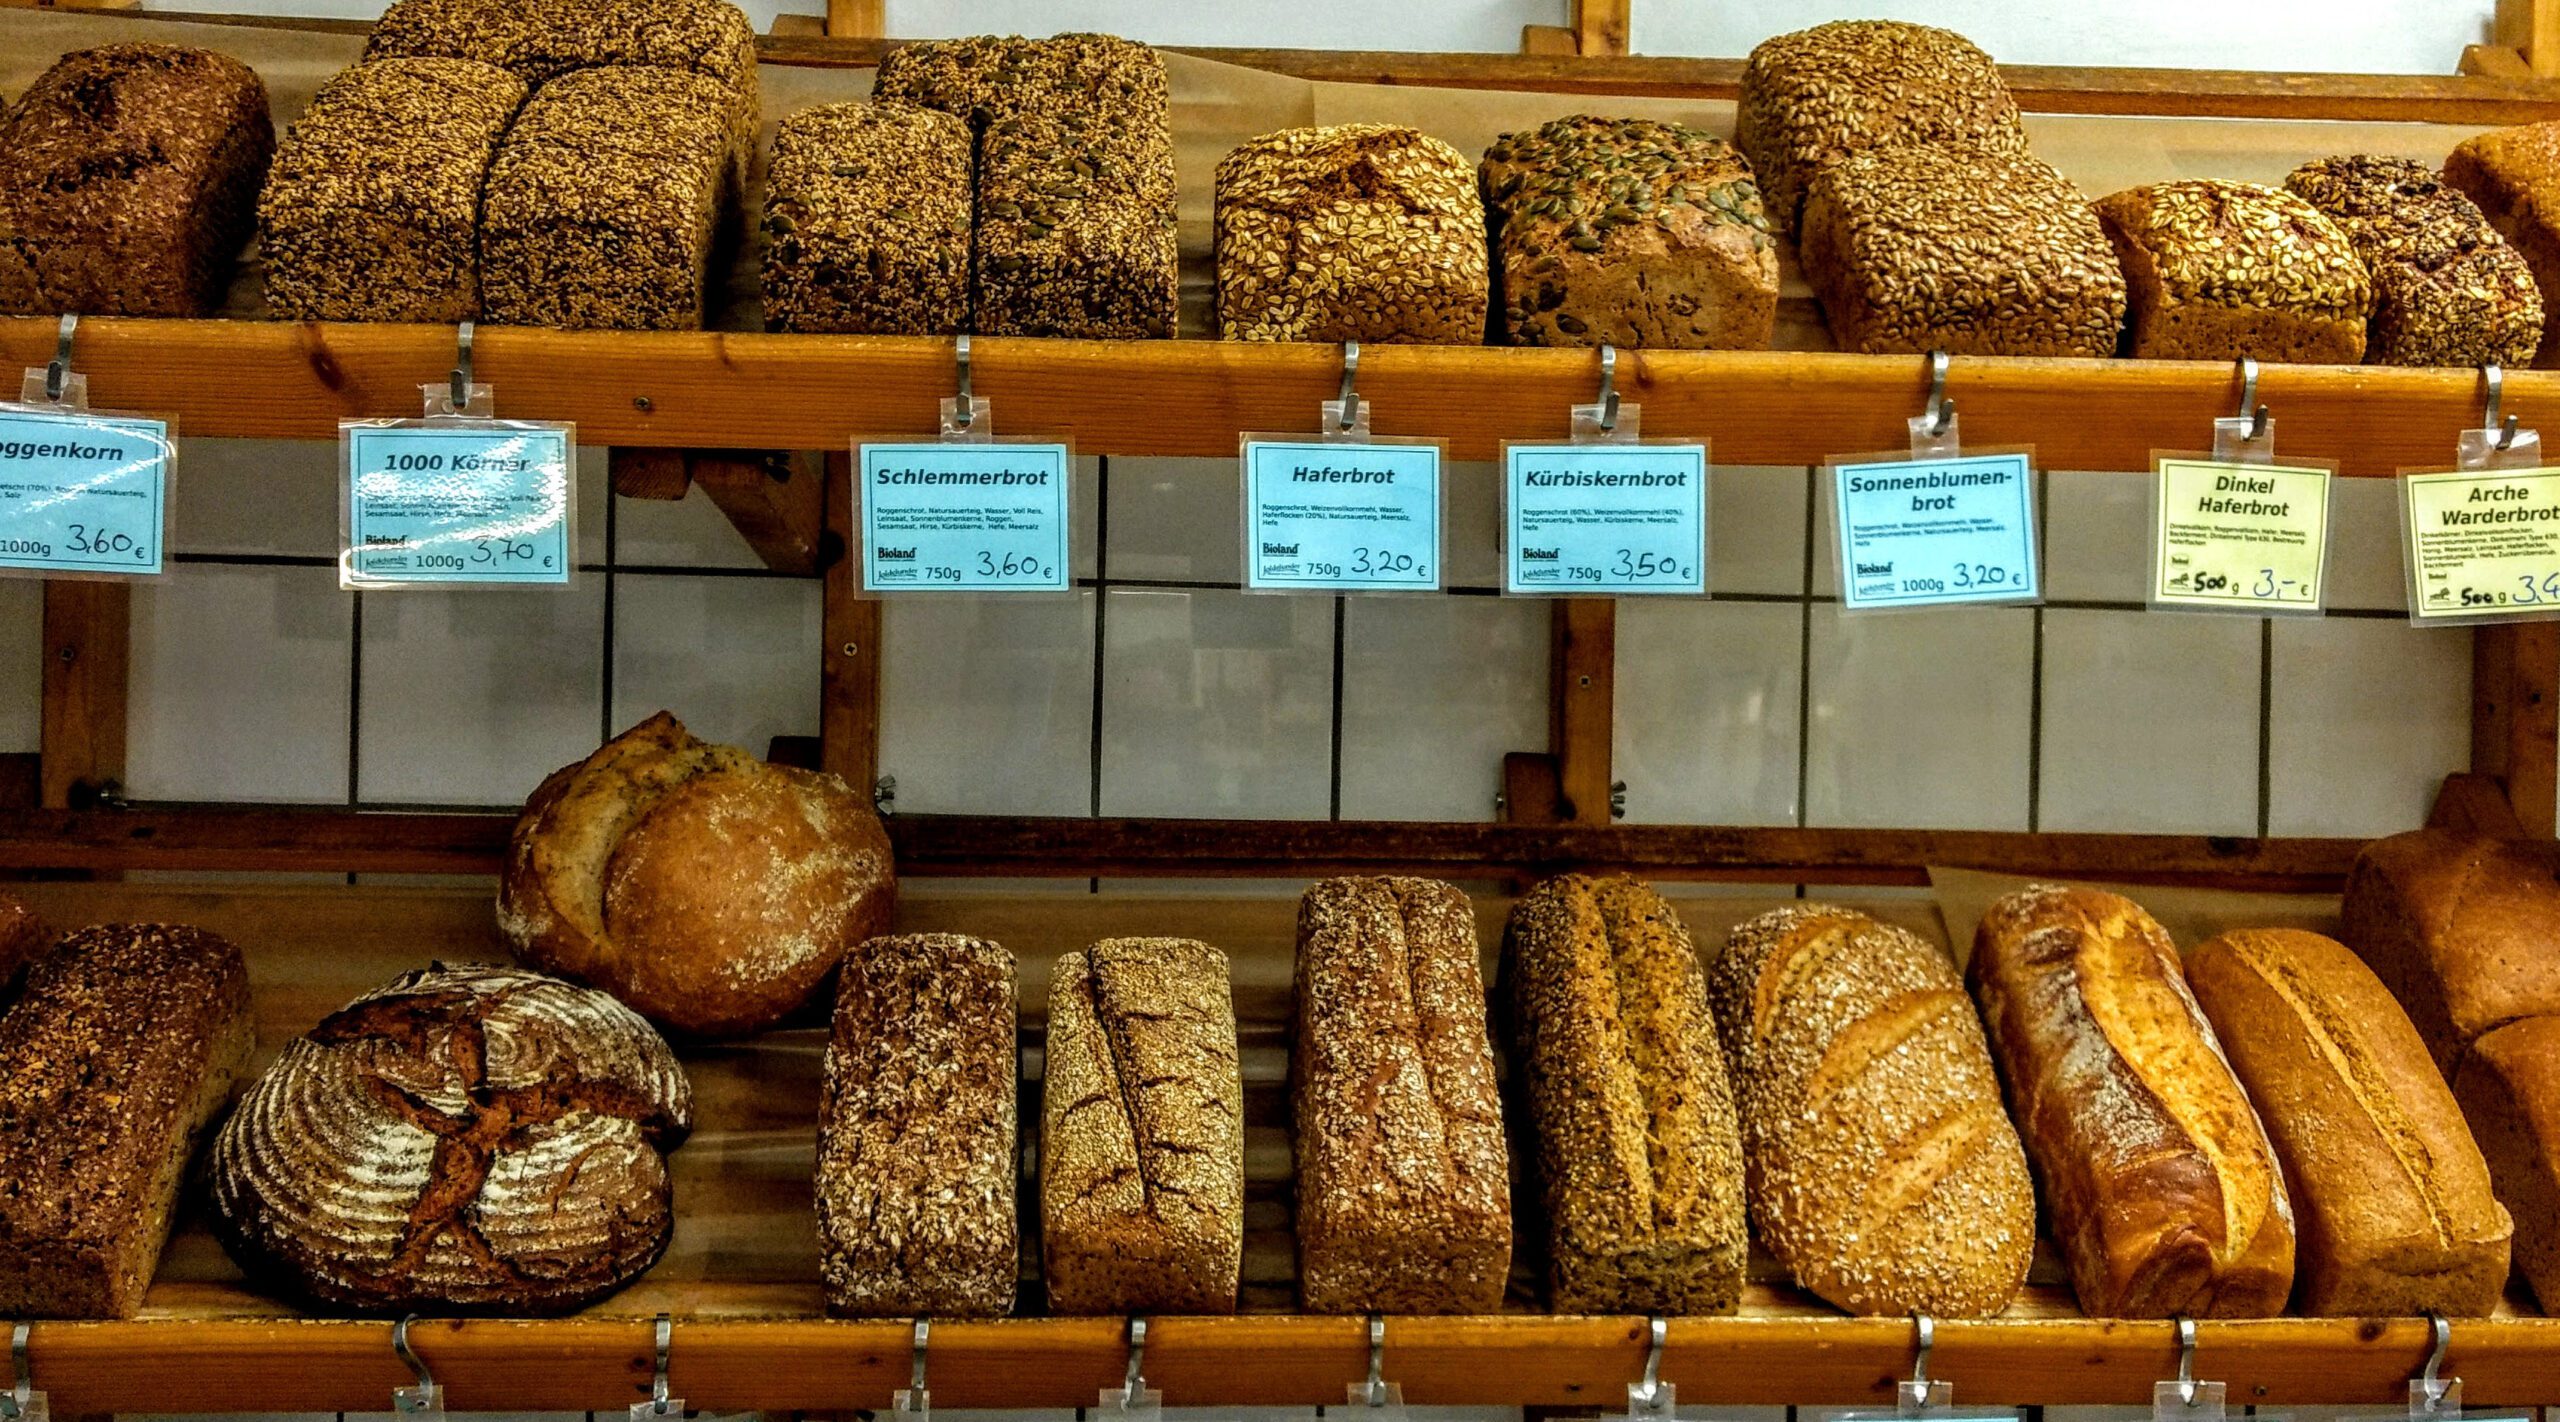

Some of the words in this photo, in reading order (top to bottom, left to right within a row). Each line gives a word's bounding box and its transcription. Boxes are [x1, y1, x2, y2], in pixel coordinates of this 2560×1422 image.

[0, 442, 123, 460] ggenkorn
[385, 455, 443, 471] 1000
[451, 454, 531, 471] Körner
[877, 469, 1048, 485] Schlemmerbrot
[1293, 467, 1395, 484] Haferbrot
[1525, 471, 1687, 487] Kürbiskernbrot
[1850, 471, 2012, 492] Sonnenblumen-
[2216, 476, 2275, 494] Dinkel
[2468, 485, 2529, 503] Arche
[929, 507, 982, 515] Natursauerteig,
[1912, 495, 1956, 511] brot
[2198, 497, 2289, 517] Haferbrot
[1329, 513, 1379, 521] Natursauerteig,
[2442, 506, 2560, 525] Warderbrot
[0, 540, 50, 557] 1000g
[66, 524, 132, 554] 3,60
[135, 547, 144, 559] €
[366, 535, 407, 545] Bioland
[1263, 543, 1299, 554] Bioland
[417, 556, 464, 570] 1000g
[471, 536, 534, 566] 3,70
[544, 556, 552, 567] €
[878, 547, 917, 558] Bioland
[1523, 548, 1560, 559] Bioland
[925, 567, 961, 581] 750g
[977, 551, 1038, 578] 3,60
[1044, 567, 1052, 578] €
[1307, 563, 1341, 577] 750g
[1351, 548, 1412, 576] 3,20
[1418, 565, 1426, 576] €
[1568, 567, 1601, 581] 750g
[1611, 549, 1676, 581] 3,50
[1682, 568, 1690, 579] €
[1856, 561, 1893, 575] Bioland
[1903, 579, 1944, 592] 1000g
[1953, 563, 2005, 588] 3,20
[2013, 573, 2021, 585] €
[2194, 571, 2227, 592] 500
[2232, 582, 2239, 595] g
[2301, 585, 2308, 596] €
[2461, 587, 2493, 606] 500
[2499, 592, 2506, 603] g
